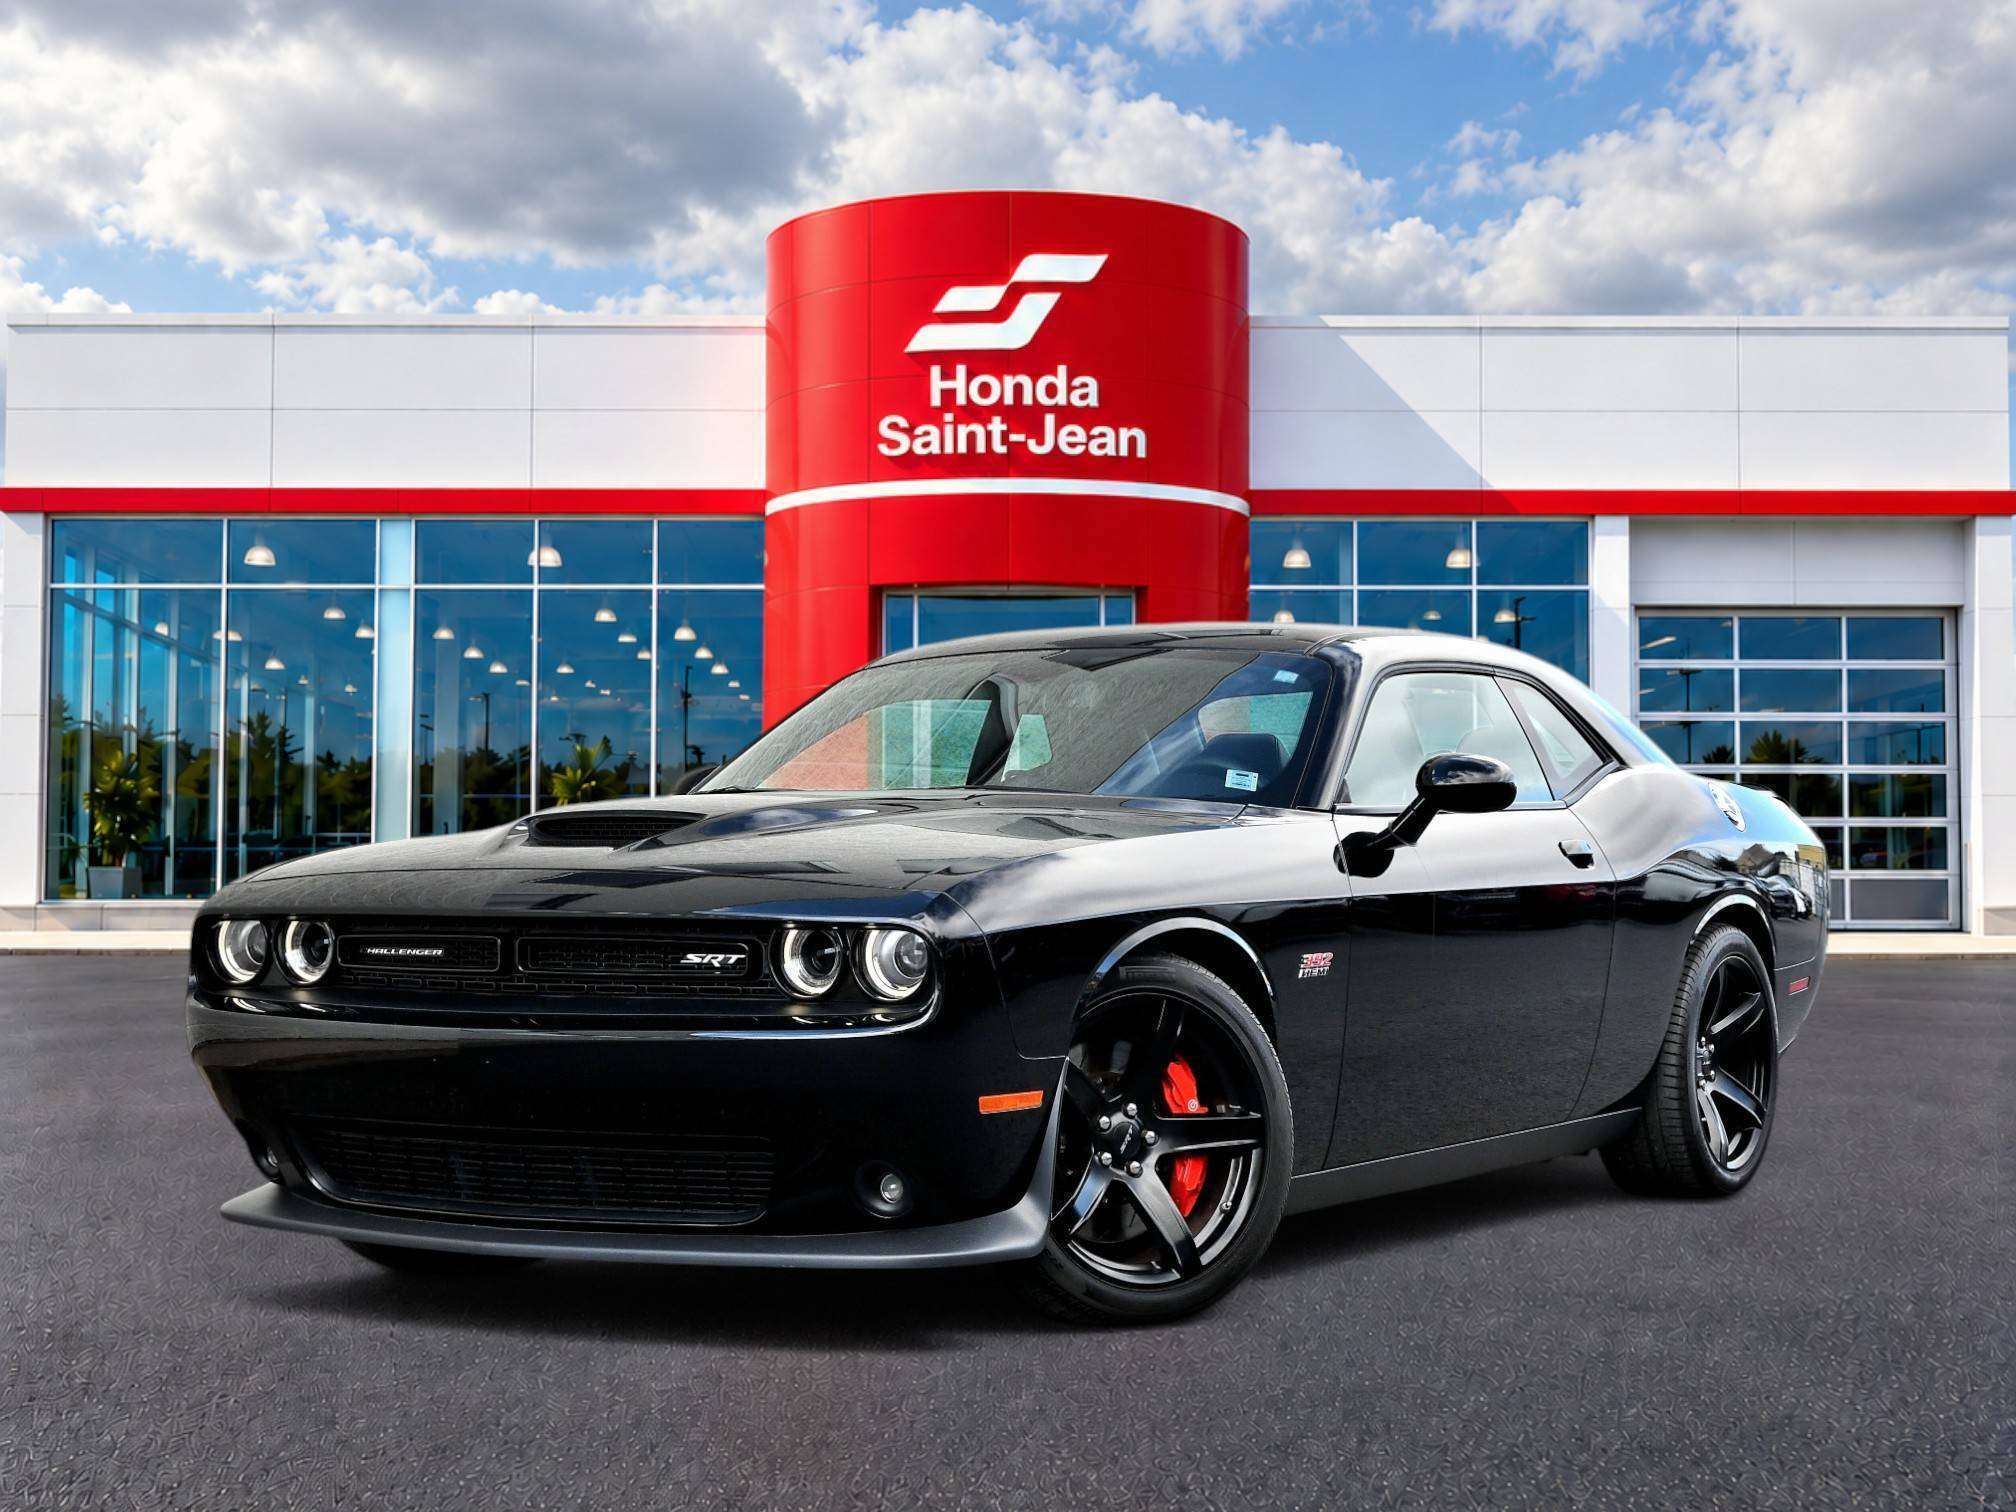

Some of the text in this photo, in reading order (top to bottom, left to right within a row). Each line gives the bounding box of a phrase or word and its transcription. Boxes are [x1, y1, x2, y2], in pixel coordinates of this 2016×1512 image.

[930, 365, 1098, 407] Honda
[877, 413, 1147, 458] Saint-Jean
[360, 947, 443, 956] HALLENGER
[680, 954, 746, 967] SRT
[1300, 952, 1334, 967] 392
